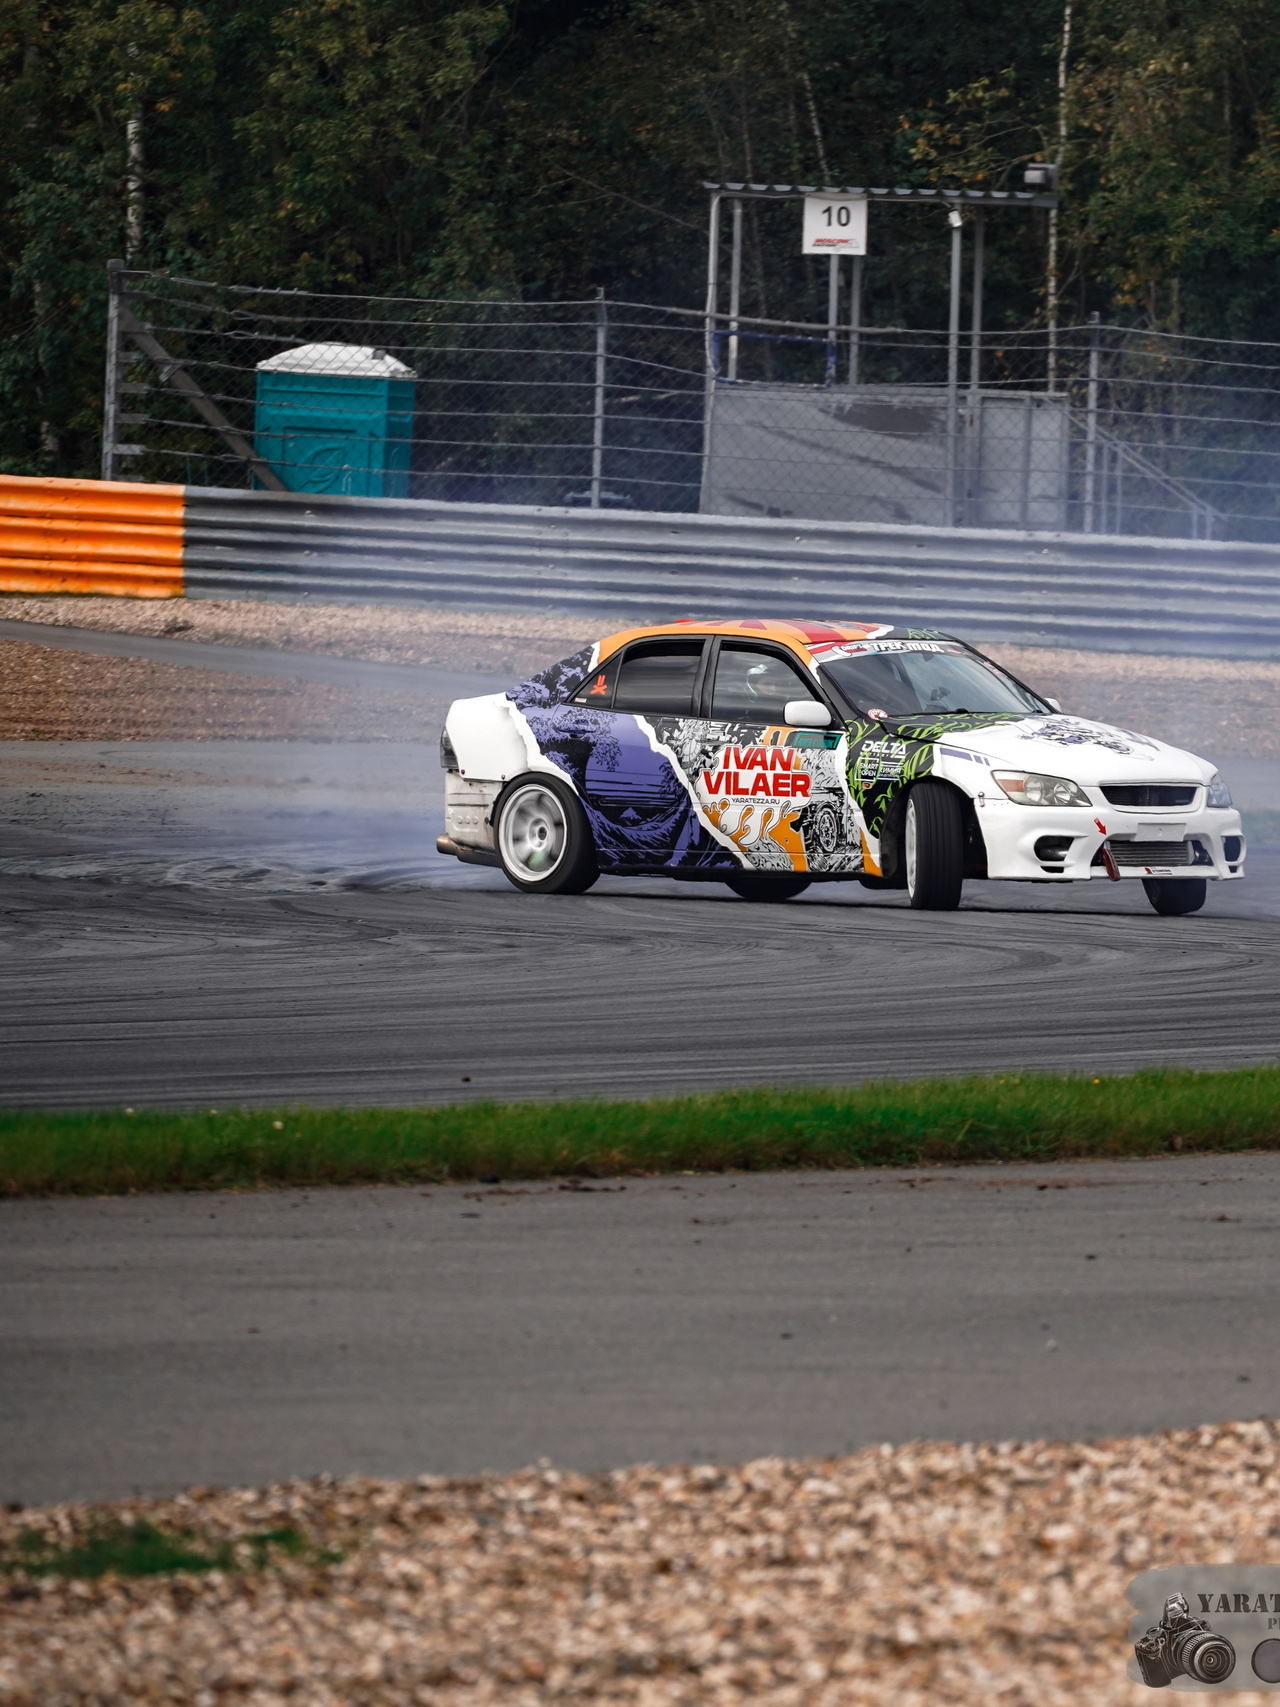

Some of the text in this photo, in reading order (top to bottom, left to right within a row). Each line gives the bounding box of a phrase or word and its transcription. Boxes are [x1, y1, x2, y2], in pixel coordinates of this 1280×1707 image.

[821, 205, 851, 227] 10
[861, 740, 907, 755] DELTA
[723, 746, 795, 772] IVAN
[703, 771, 811, 798] VILAER
[730, 797, 781, 805] YARATEZZA.RU
